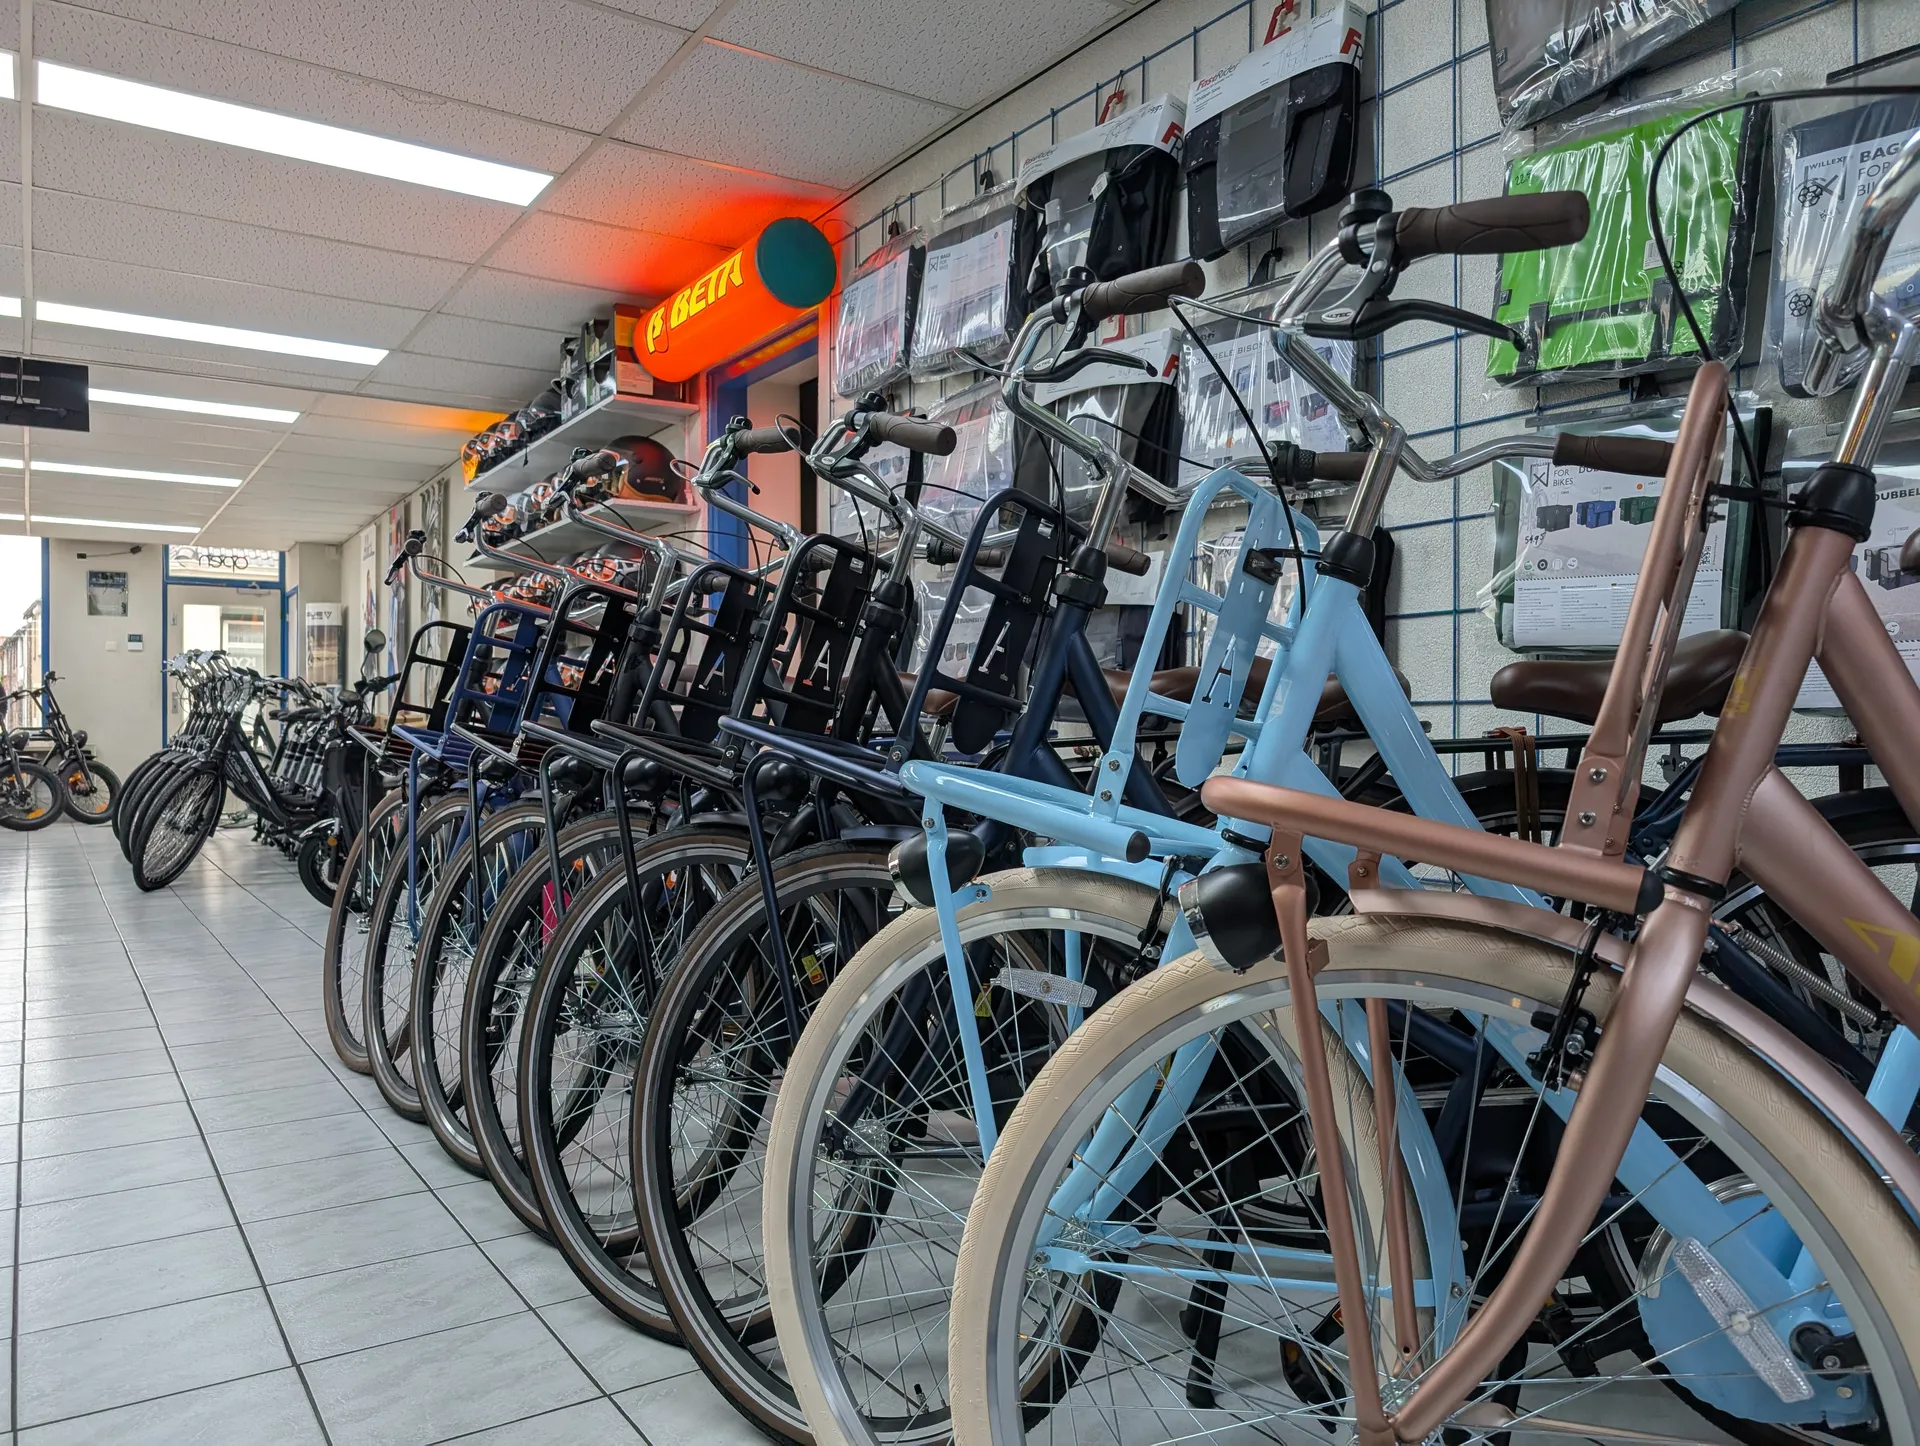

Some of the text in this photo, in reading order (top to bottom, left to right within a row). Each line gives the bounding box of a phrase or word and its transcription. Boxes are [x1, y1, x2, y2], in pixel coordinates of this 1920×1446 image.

[1859, 142, 1904, 164] BAG
[670, 249, 744, 330] BETA
[1325, 311, 1352, 319] ALTEC
[1553, 478, 1573, 487] BIKES
